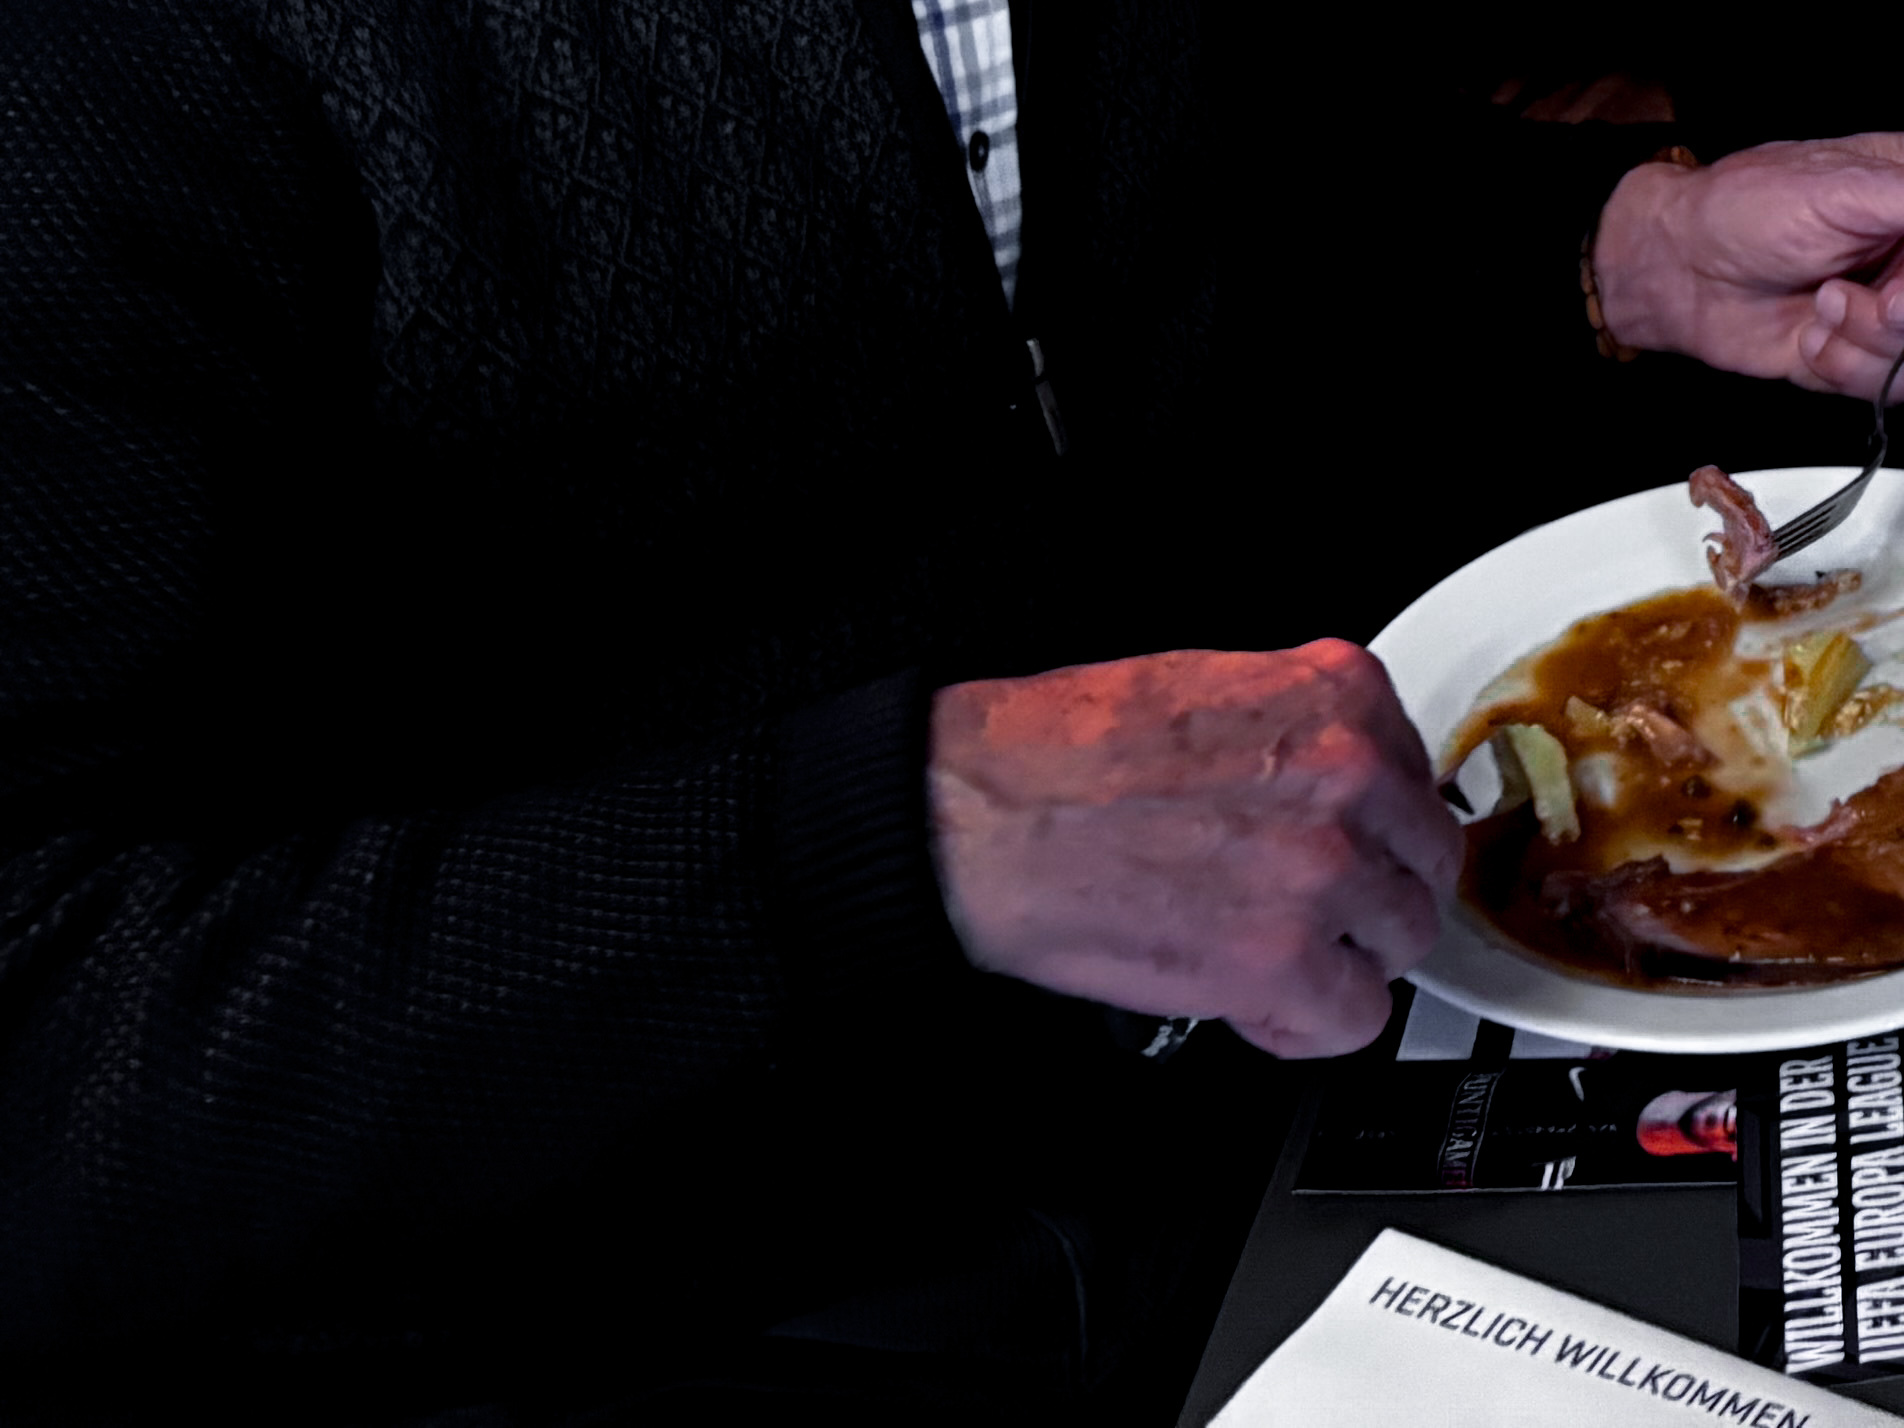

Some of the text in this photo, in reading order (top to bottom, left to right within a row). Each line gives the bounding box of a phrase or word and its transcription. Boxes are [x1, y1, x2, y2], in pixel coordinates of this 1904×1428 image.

[1845, 1036, 1904, 1145] LEAGUE
[1778, 1054, 1845, 1375] WILLKOMMEN IN DER
[1369, 1275, 1811, 1428] HERZLICH WILLKOMMEN
